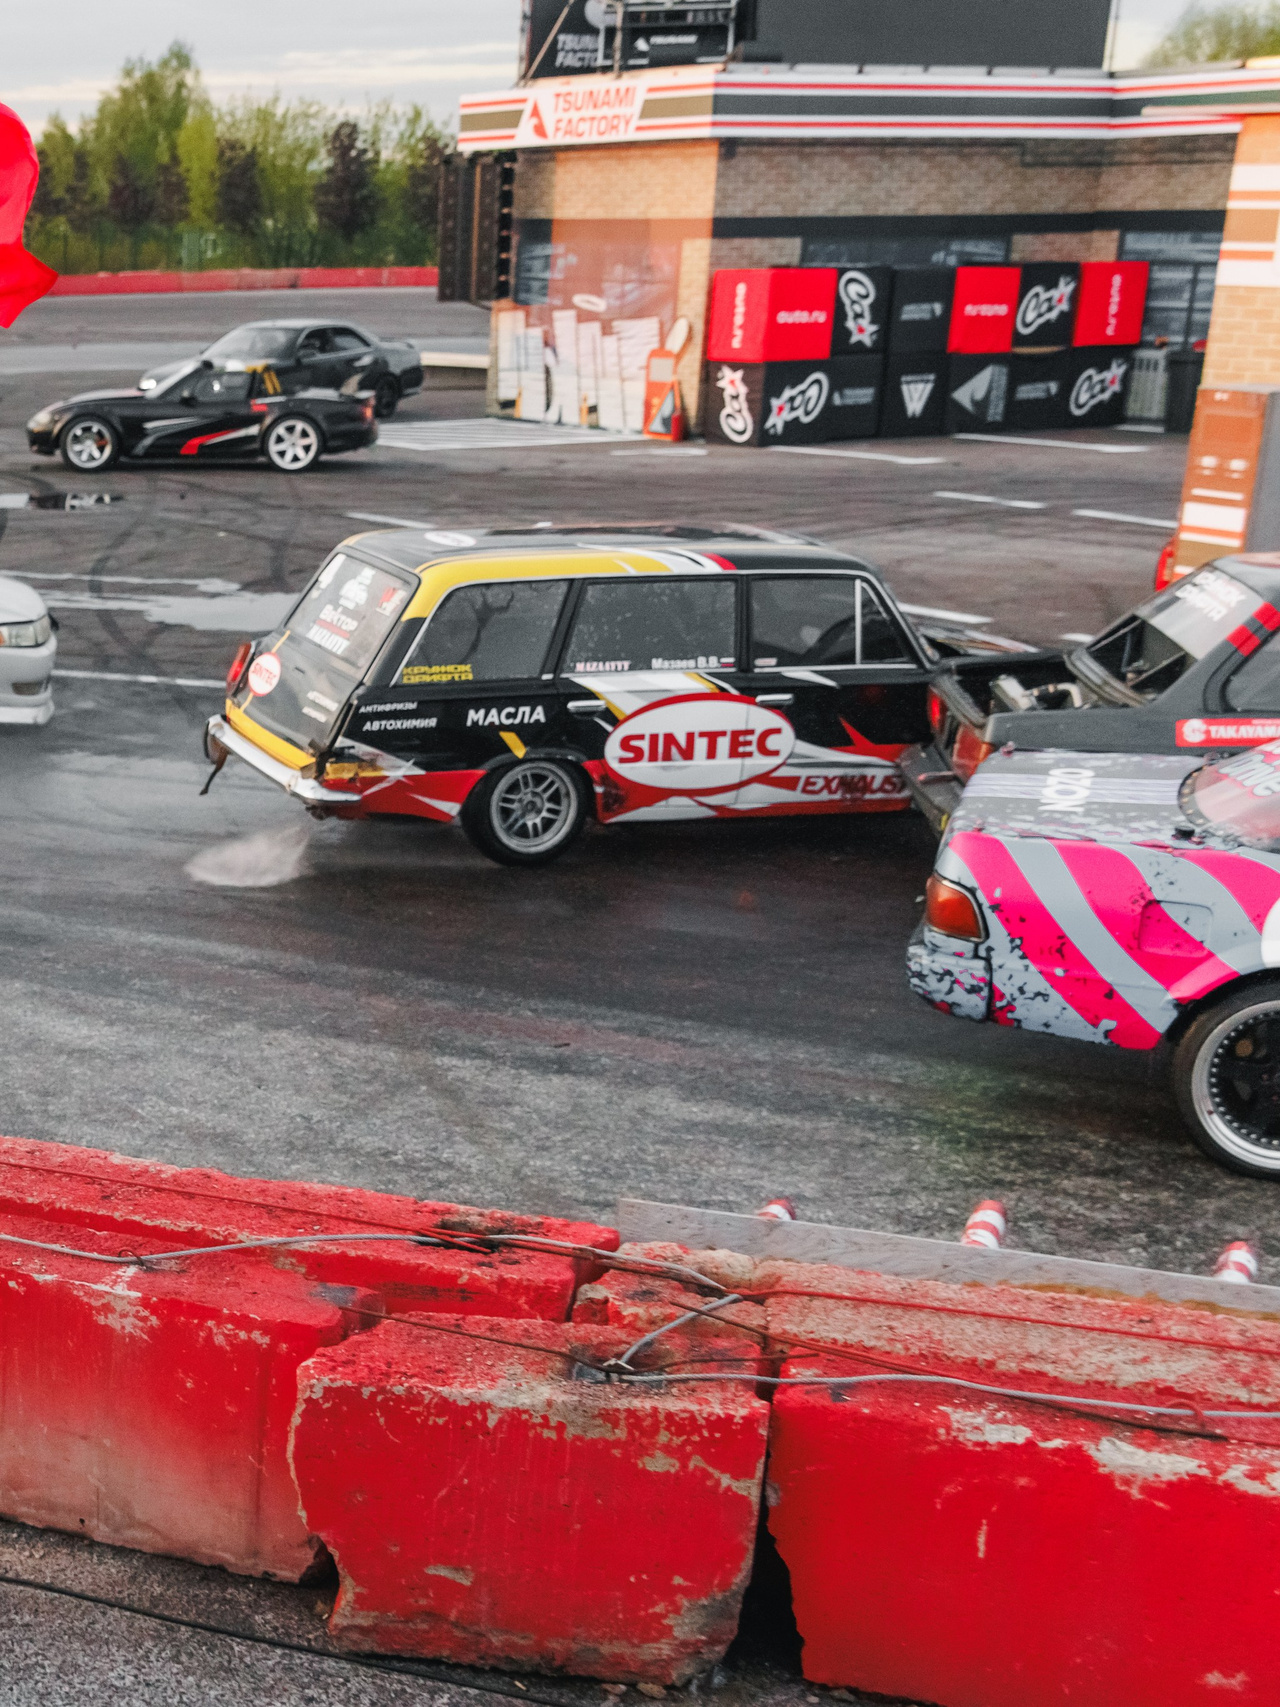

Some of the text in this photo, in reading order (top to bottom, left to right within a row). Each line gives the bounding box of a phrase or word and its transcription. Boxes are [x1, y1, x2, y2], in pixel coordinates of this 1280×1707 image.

[554, 86, 637, 113] TSUNAMI
[553, 113, 634, 139] FACTORY
[776, 310, 827, 325] auto.ru
[358, 701, 418, 714] АНТИФРИЗЫ
[466, 705, 547, 728] МАСЛА
[362, 717, 438, 732] АВТОХИМИЯ
[618, 727, 783, 764] SINTEC
